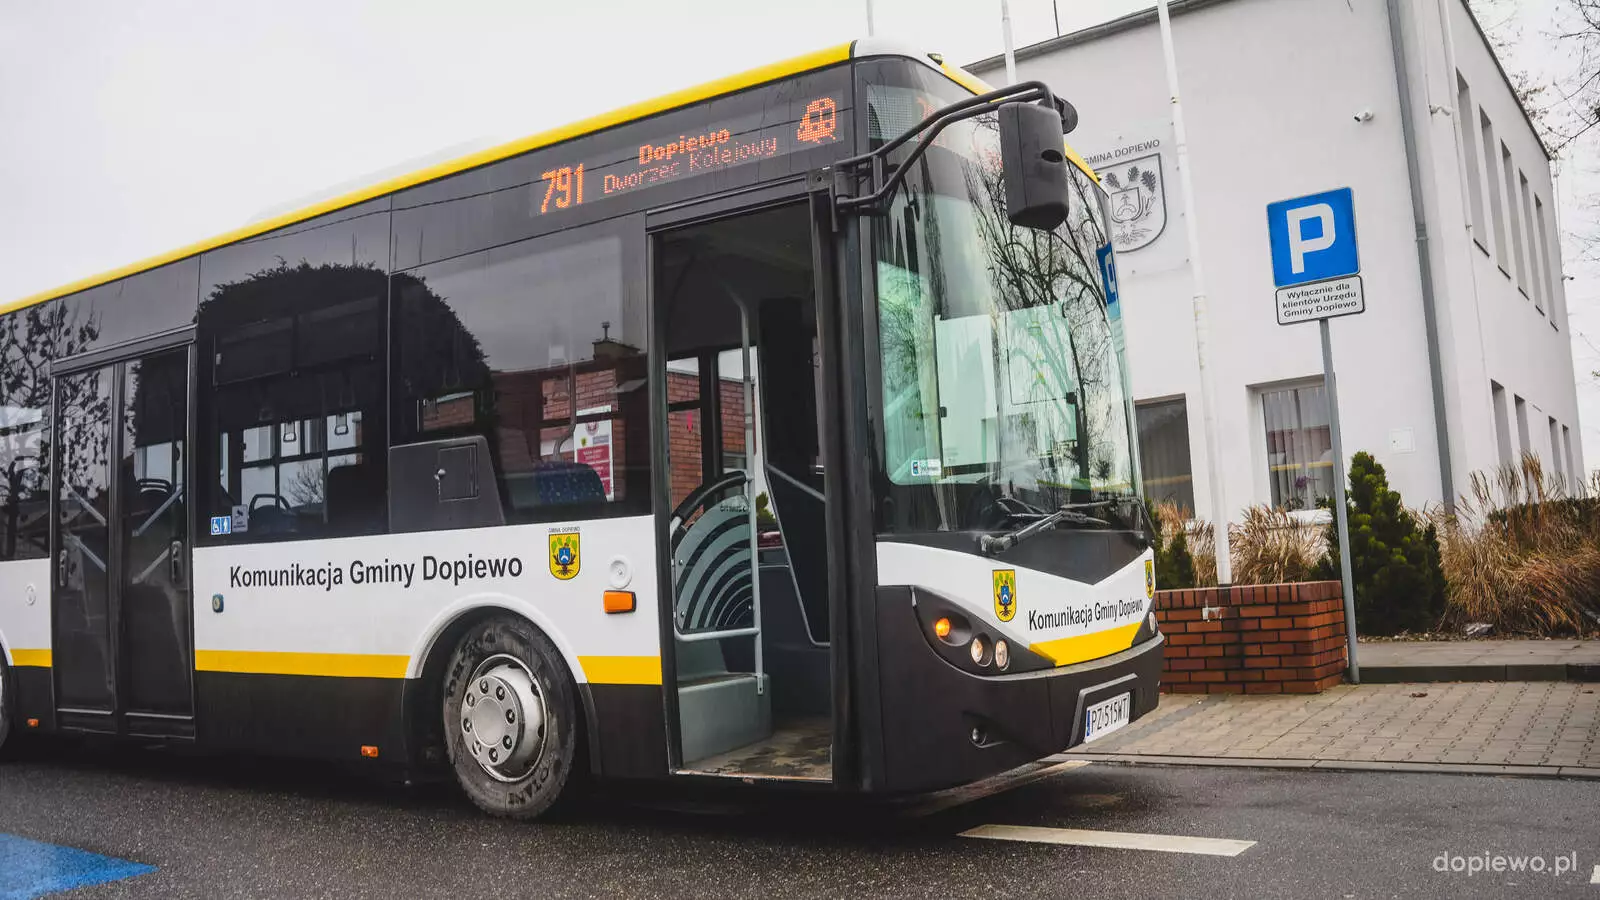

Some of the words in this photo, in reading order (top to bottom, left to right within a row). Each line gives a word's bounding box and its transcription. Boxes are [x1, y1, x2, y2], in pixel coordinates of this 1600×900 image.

[639, 129, 730, 165] Dopiewo
[1114, 139, 1160, 158] DOPIEWO
[604, 160, 681, 193] Dworzec
[689, 137, 777, 171] Kolejowy
[541, 163, 584, 213] 791
[1286, 203, 1336, 274] P
[1282, 297, 1320, 309] klientów
[1323, 291, 1357, 302] Urzędu
[1287, 287, 1333, 299] Wyłącznie
[1335, 283, 1350, 291] dla
[1284, 308, 1313, 318] Gminy
[1316, 301, 1357, 313] Dopiewo
[230, 562, 343, 592] Komunikacja
[350, 558, 415, 588] Gminy
[423, 553, 523, 586] Dopiewo
[1028, 604, 1093, 631] Komunikacja
[1094, 601, 1118, 622] Gminy
[1119, 599, 1143, 620] Dopiewo
[1092, 708, 1102, 733] PZ
